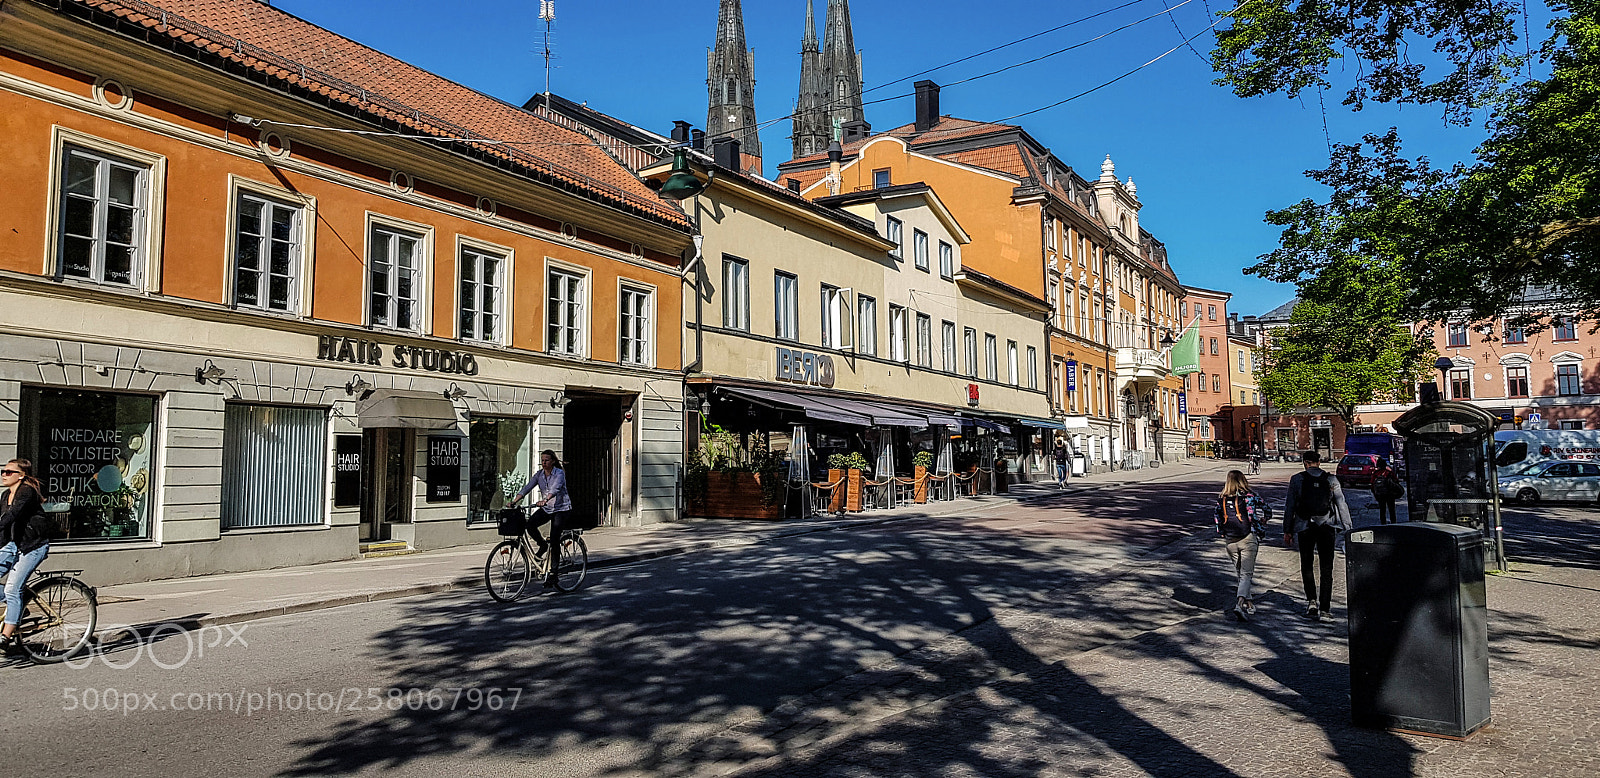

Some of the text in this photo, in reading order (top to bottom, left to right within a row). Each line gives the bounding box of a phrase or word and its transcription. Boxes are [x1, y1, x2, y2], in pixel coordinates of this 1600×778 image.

[317, 335, 478, 376] HAIR STUDIO
[51, 428, 122, 443] INREDARE
[50, 446, 121, 460] STYLISTER
[431, 441, 459, 456] HAIR
[337, 453, 360, 464] HAIR
[430, 456, 459, 466] STUDIO
[49, 463, 95, 474] KONTOR
[337, 463, 360, 472] STUDIO
[48, 477, 93, 493] BUTIK
[47, 494, 121, 507] INSPIRATION
